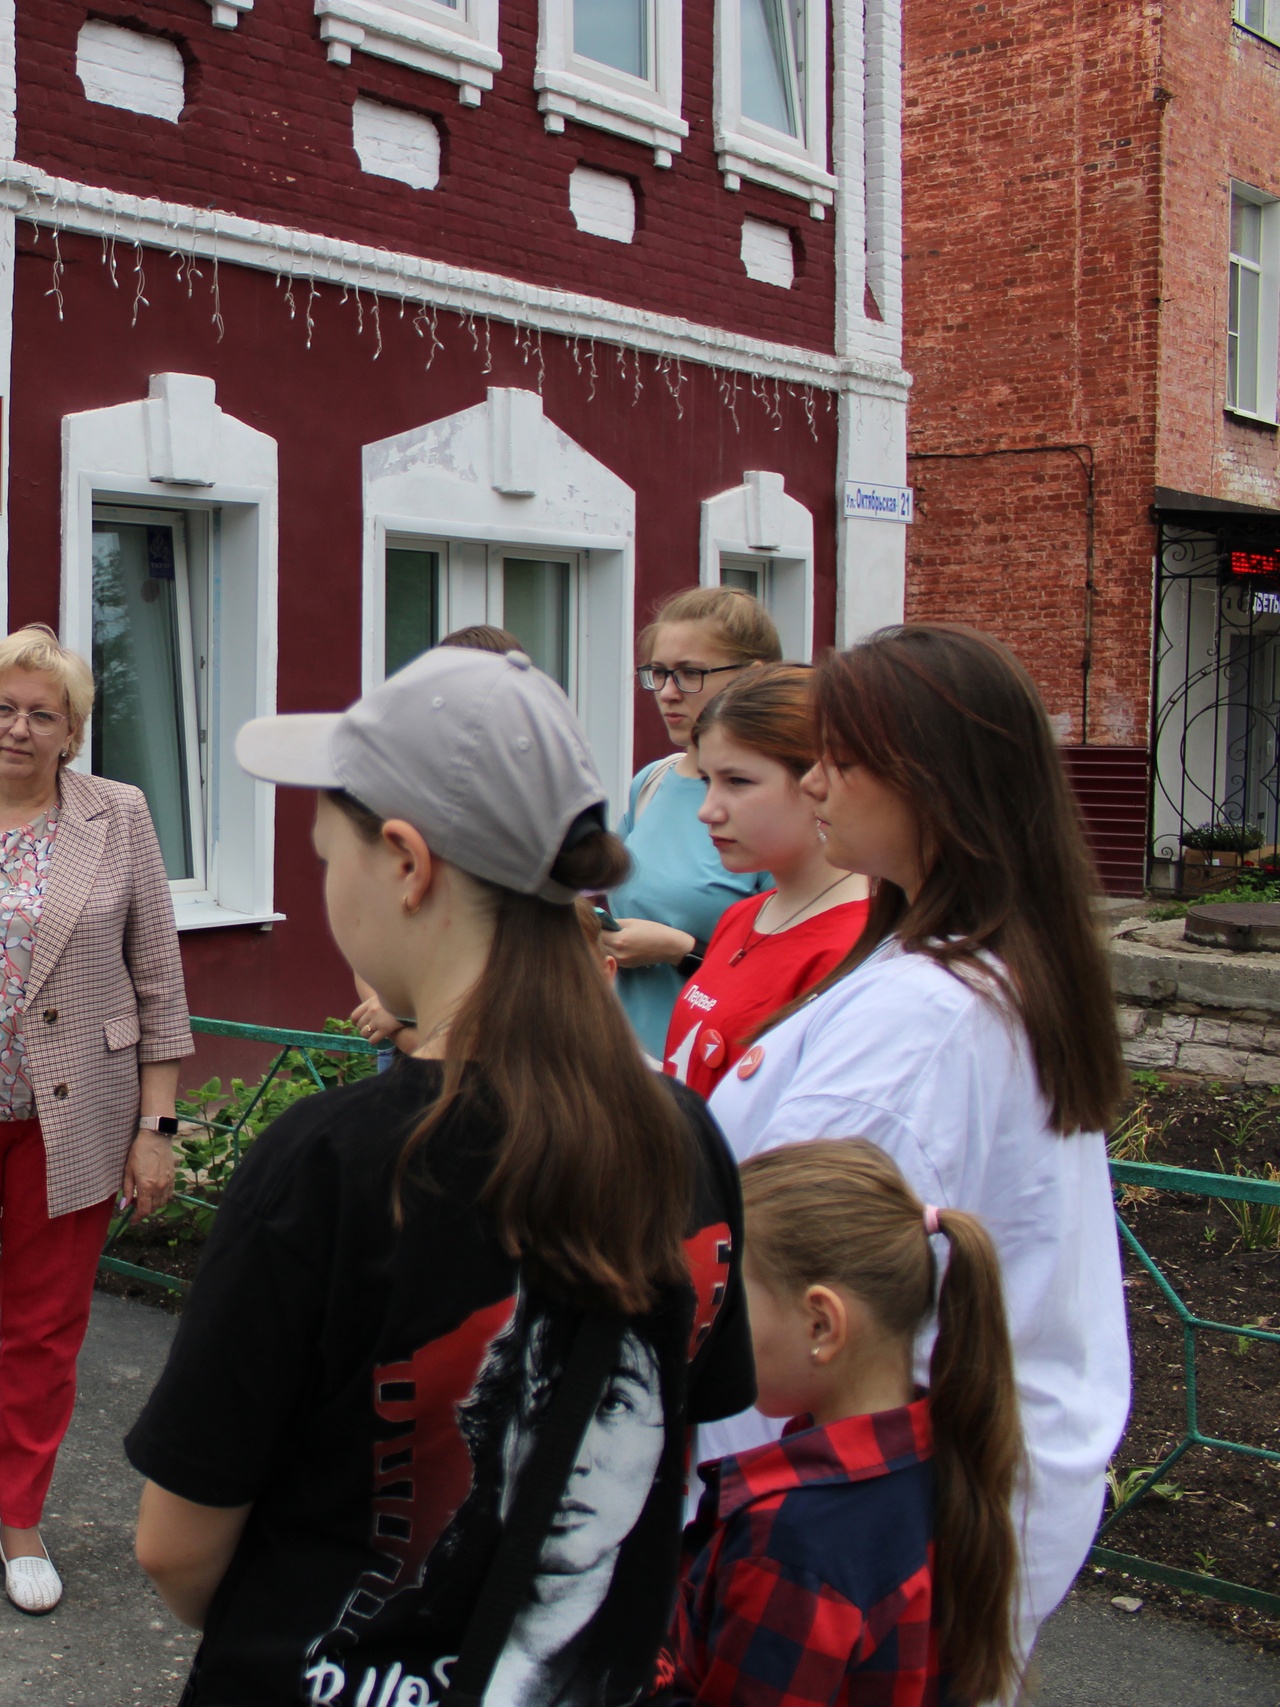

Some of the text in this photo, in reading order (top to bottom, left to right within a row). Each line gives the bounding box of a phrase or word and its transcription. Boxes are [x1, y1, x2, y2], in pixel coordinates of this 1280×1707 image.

[856, 488, 897, 516] Октябрьская
[900, 493, 910, 516] 21
[684, 984, 717, 1012] Первые
